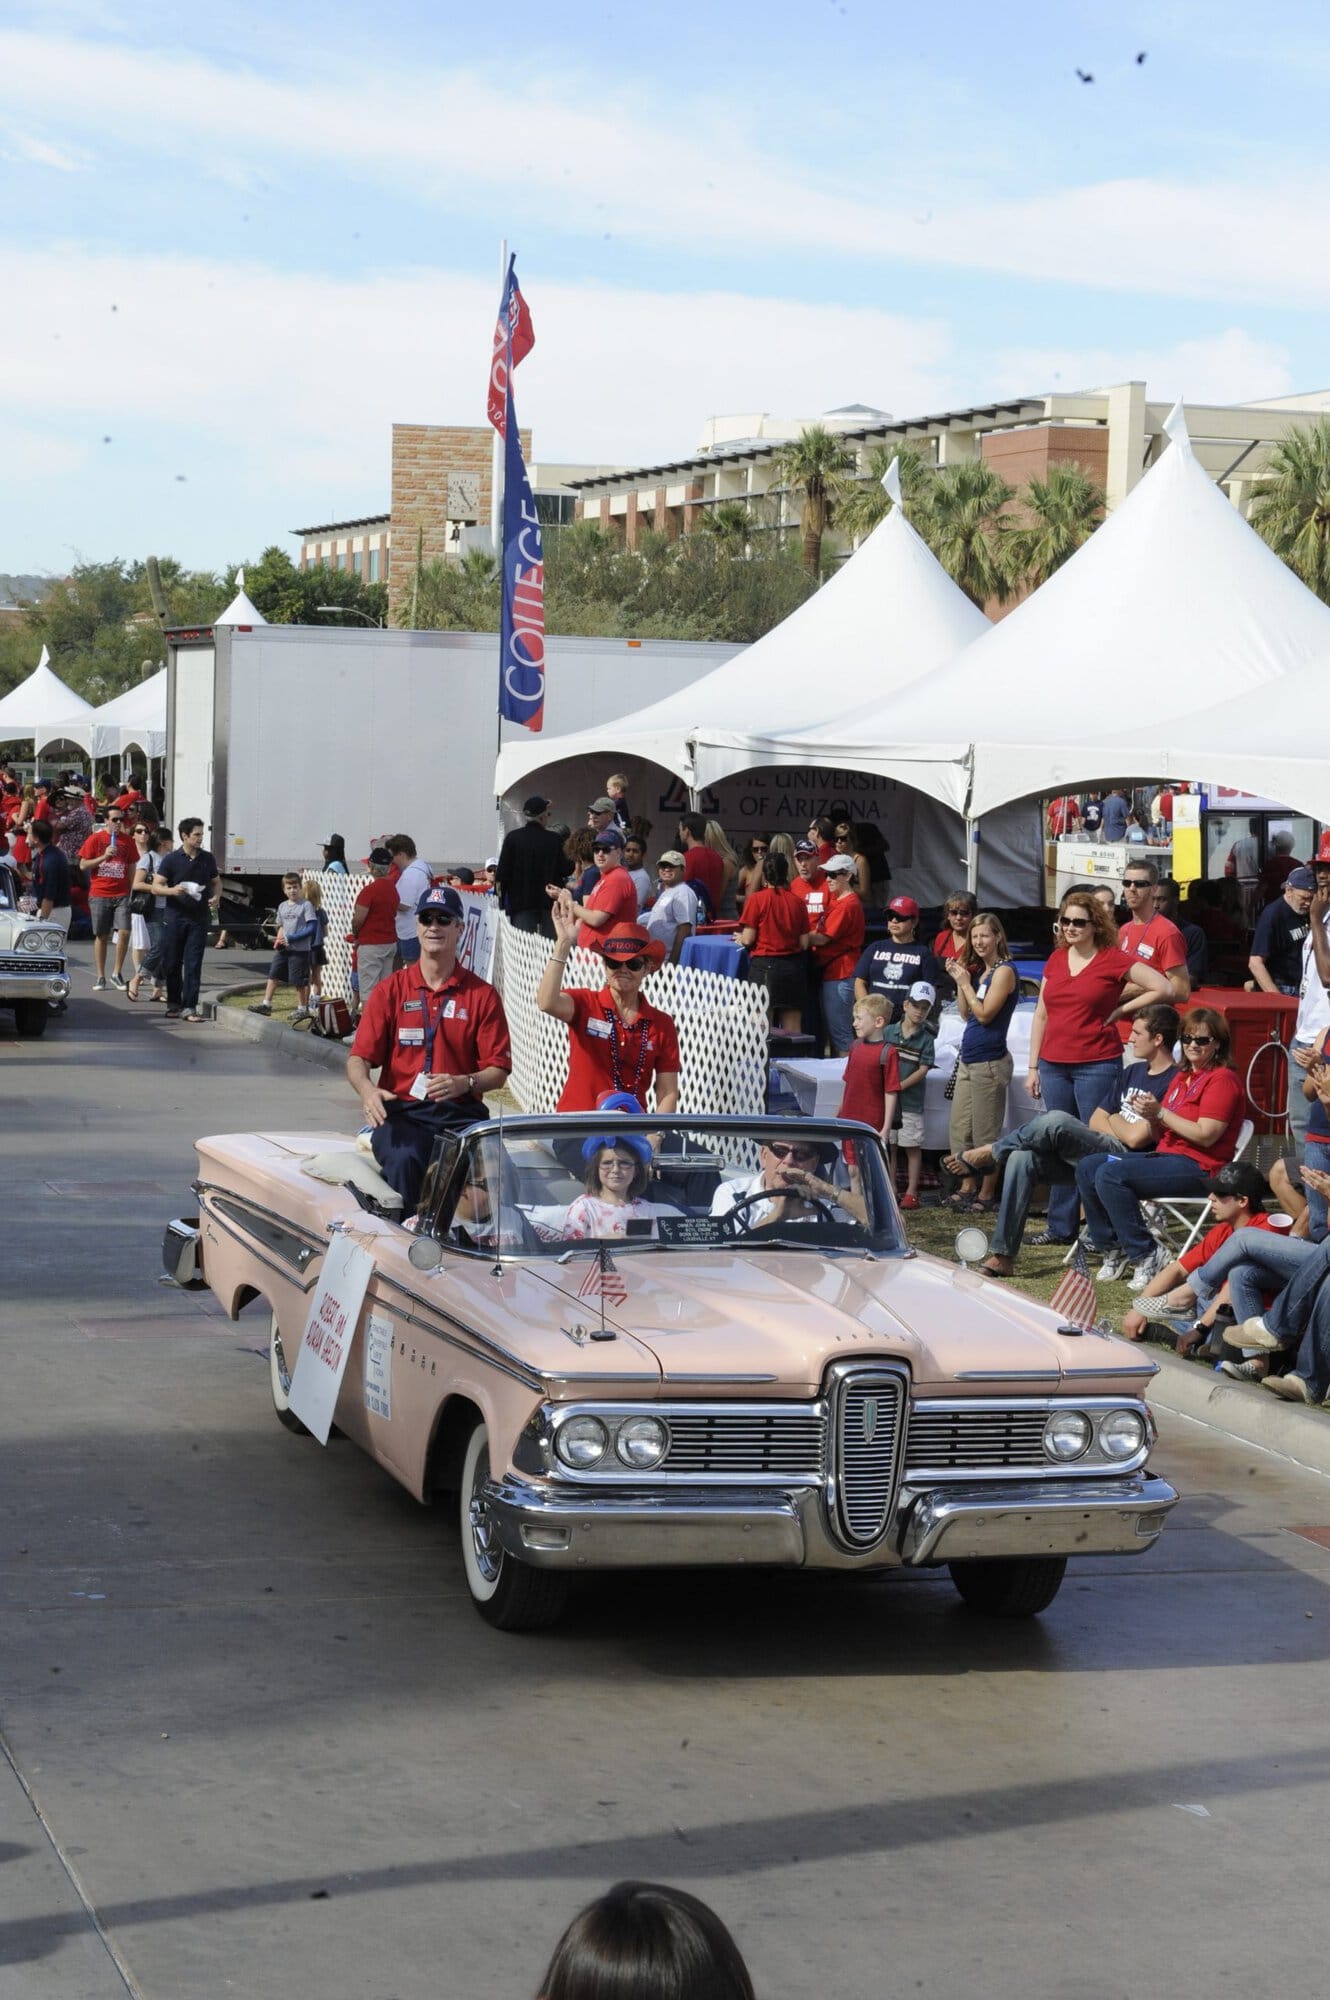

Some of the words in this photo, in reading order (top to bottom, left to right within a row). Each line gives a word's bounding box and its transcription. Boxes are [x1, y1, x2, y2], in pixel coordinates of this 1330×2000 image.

[739, 796, 769, 816] OF
[873, 950, 892, 962] LOS
[892, 952, 921, 966] GATOS
